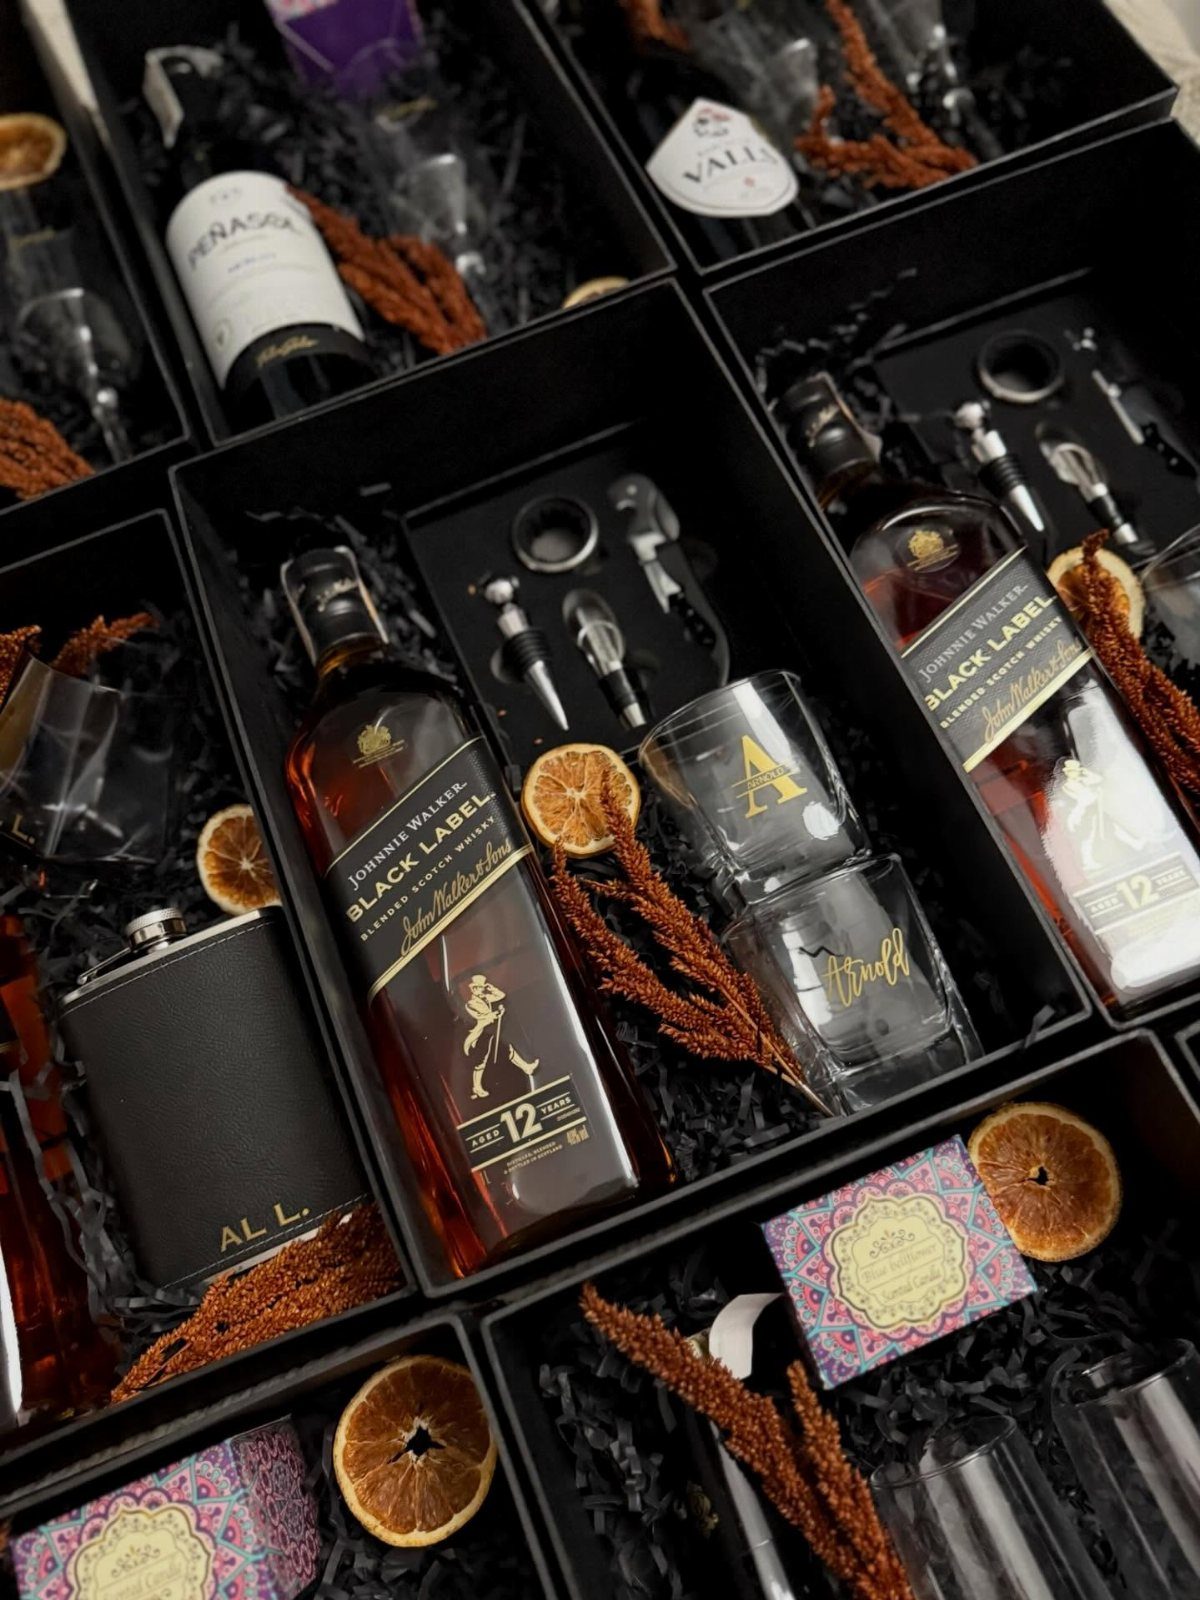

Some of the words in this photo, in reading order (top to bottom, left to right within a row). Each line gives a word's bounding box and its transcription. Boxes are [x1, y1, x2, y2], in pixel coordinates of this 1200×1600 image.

[918, 628, 976, 683] JOHNNIE
[971, 584, 1027, 630] WALKER
[924, 648, 991, 711] BLACK
[987, 595, 1056, 651] LABEL
[940, 687, 987, 729] BLENDED
[986, 651, 1025, 686] SCOTCH
[1025, 616, 1063, 649] WHISKY
[741, 734, 808, 819] A
[747, 767, 785, 789] ARNOLD
[346, 852, 420, 923] BLACK
[418, 792, 495, 855] LABEL
[347, 831, 410, 891] JOHNNIE
[406, 781, 467, 831] WALKER
[360, 895, 409, 942] BLENDED
[411, 854, 453, 893] SCOTCH
[454, 815, 495, 853] WHISKY
[401, 907, 436, 957] John
[432, 871, 480, 915] Walker
[484, 838, 513, 872] Sons
[1115, 875, 1160, 911] 12
[822, 927, 910, 1007] Arnold
[472, 1129, 500, 1148] AGED
[500, 1103, 543, 1143] 12
[540, 1096, 572, 1115] YEARS
[221, 1217, 267, 1253] AL
[273, 1202, 310, 1226] L.
